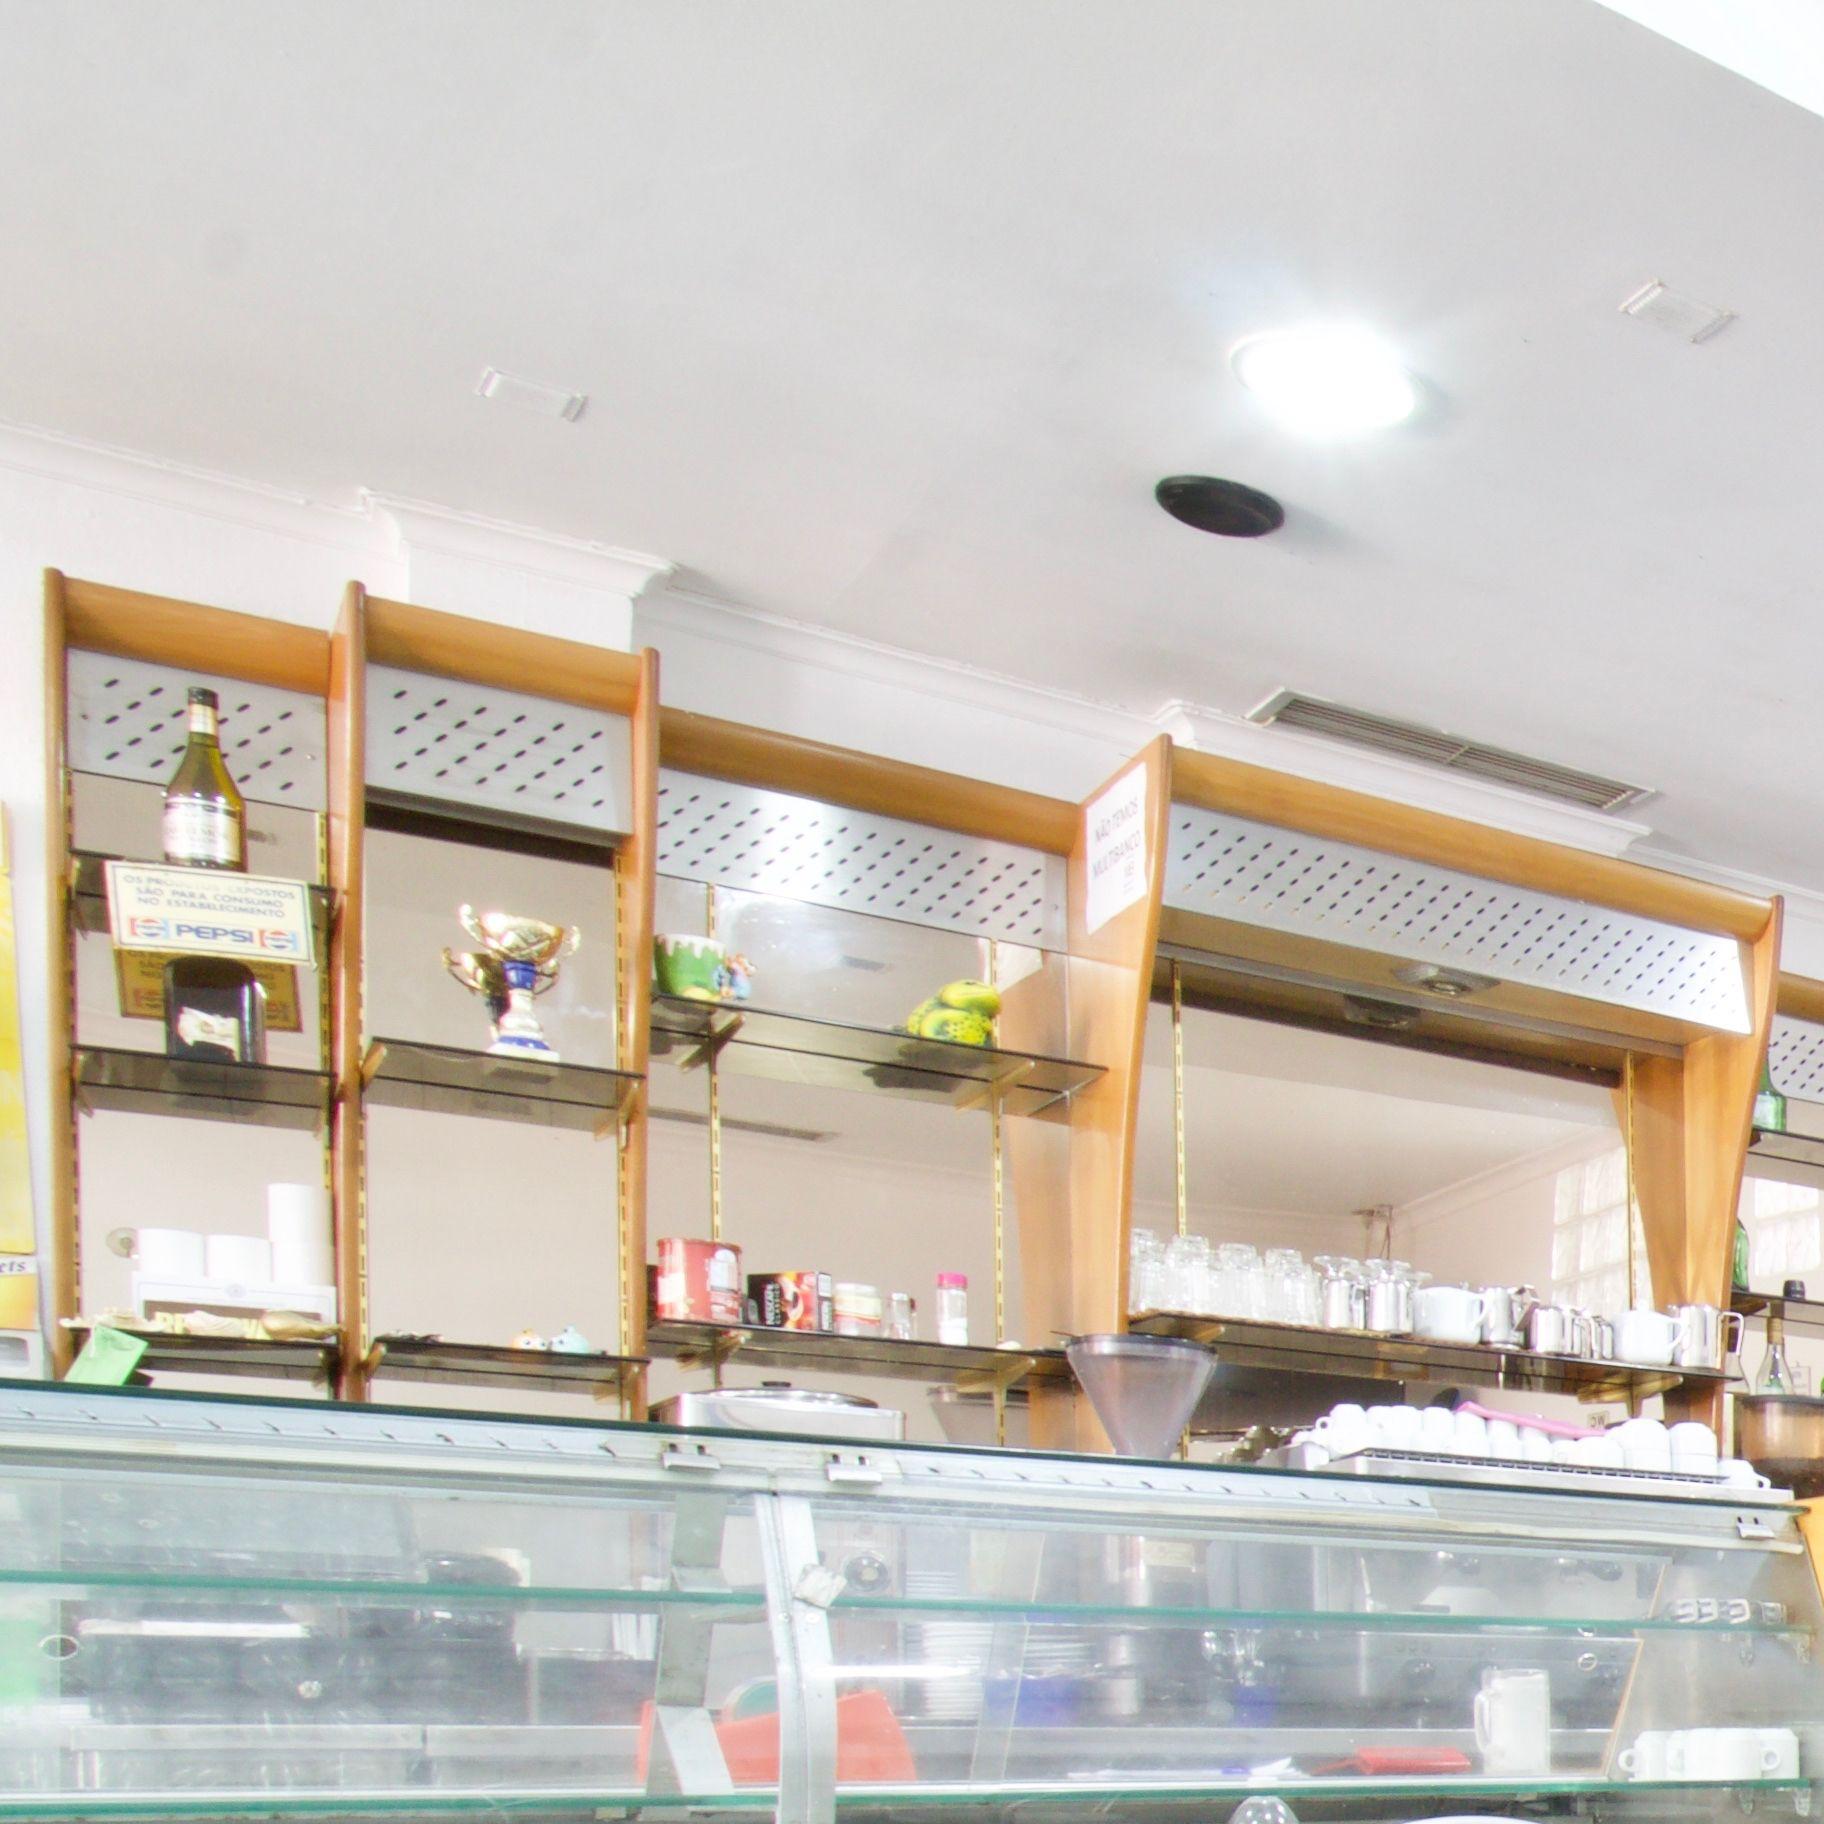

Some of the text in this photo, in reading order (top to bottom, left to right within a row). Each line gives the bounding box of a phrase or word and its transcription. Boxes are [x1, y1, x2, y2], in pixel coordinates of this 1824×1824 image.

[138, 896, 286, 918] NO ESTABELECIMENTO
[171, 888, 207, 901] PARA
[213, 893, 284, 909] CONSUMO
[175, 924, 254, 943] PEPSI
